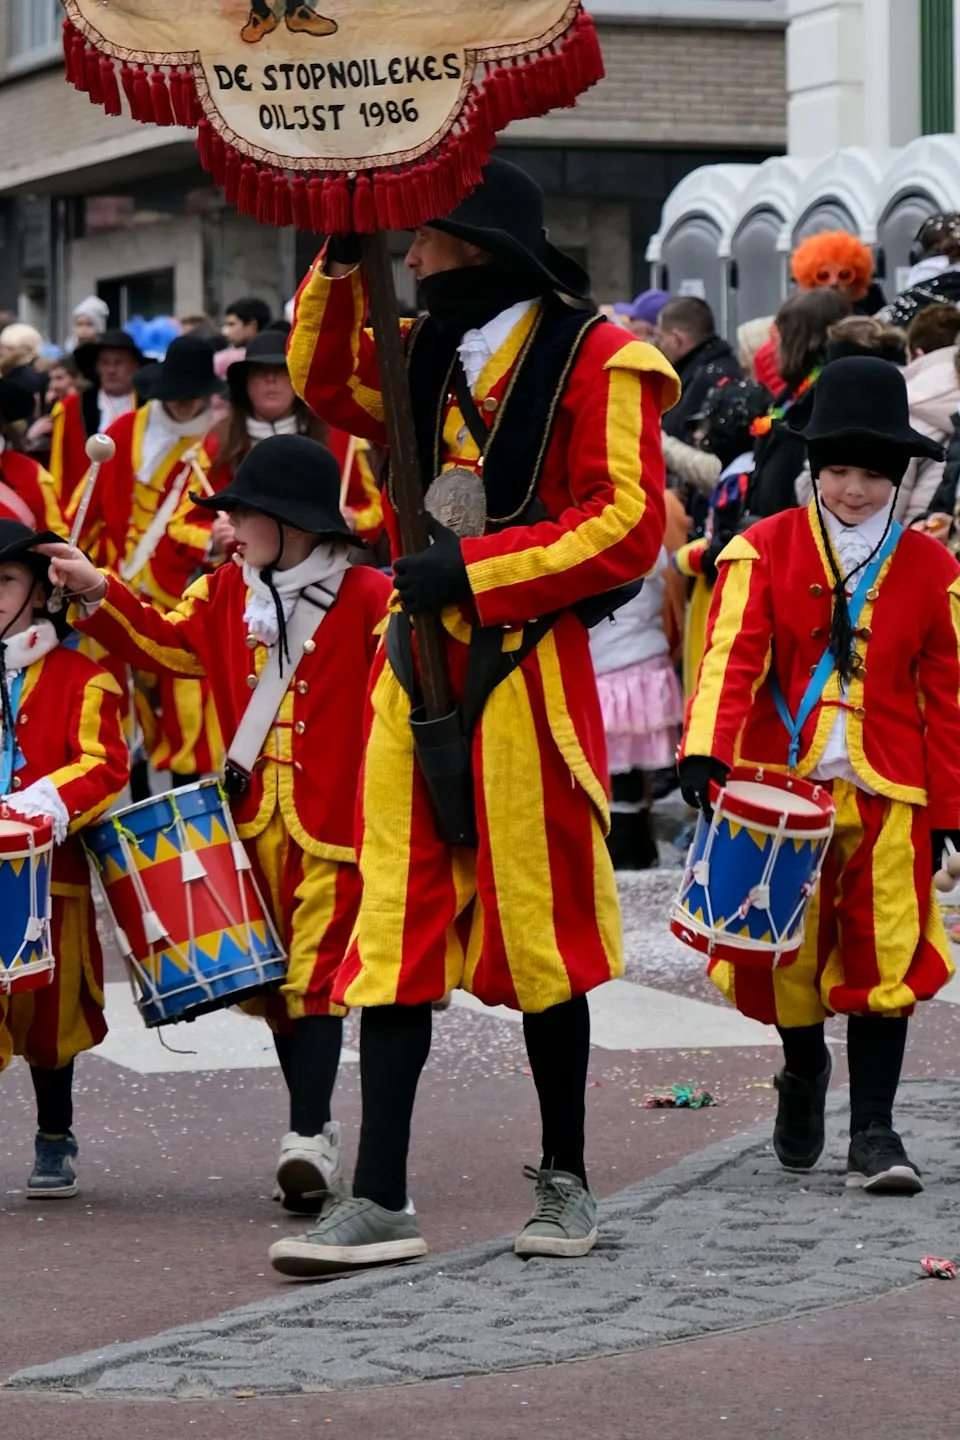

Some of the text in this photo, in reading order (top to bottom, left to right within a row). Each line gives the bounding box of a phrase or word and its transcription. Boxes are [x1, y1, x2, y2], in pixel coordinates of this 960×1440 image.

[213, 52, 462, 92] DE STOPNOILEKES
[258, 97, 420, 131] OILJST 1986
